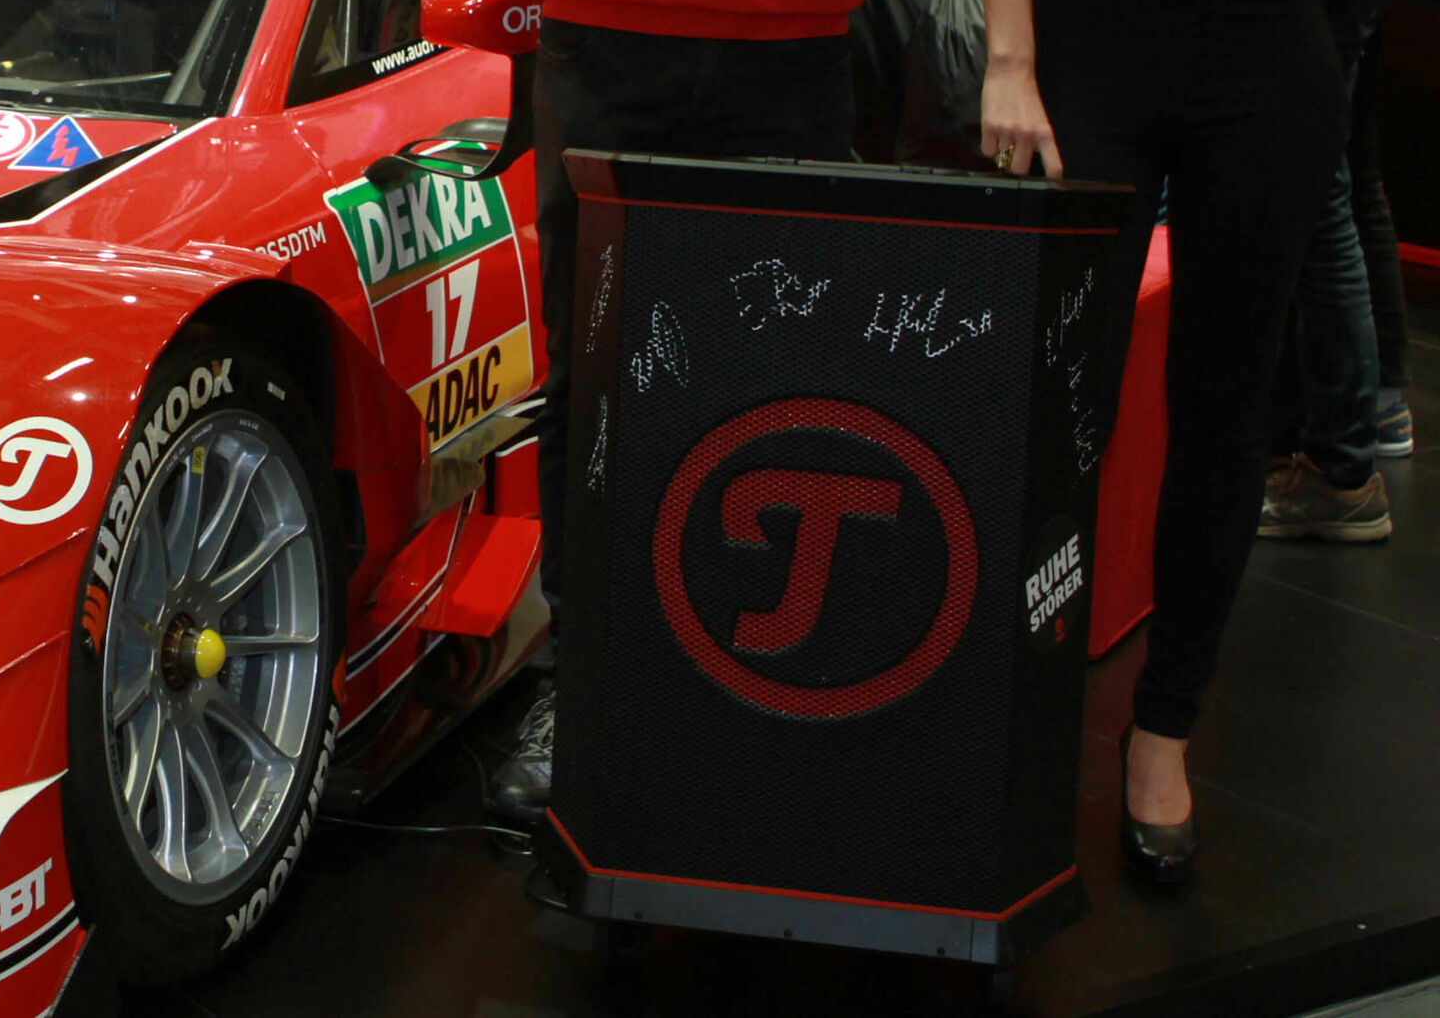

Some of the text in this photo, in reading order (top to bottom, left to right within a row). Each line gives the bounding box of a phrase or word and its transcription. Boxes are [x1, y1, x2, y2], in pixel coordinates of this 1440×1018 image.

[502, 5, 542, 33] OR
[357, 165, 492, 285] DEKRA
[425, 257, 481, 371] 17
[424, 344, 501, 443] ADAC
[1025, 533, 1081, 609] RUHE
[1029, 567, 1083, 633] STÖRER
